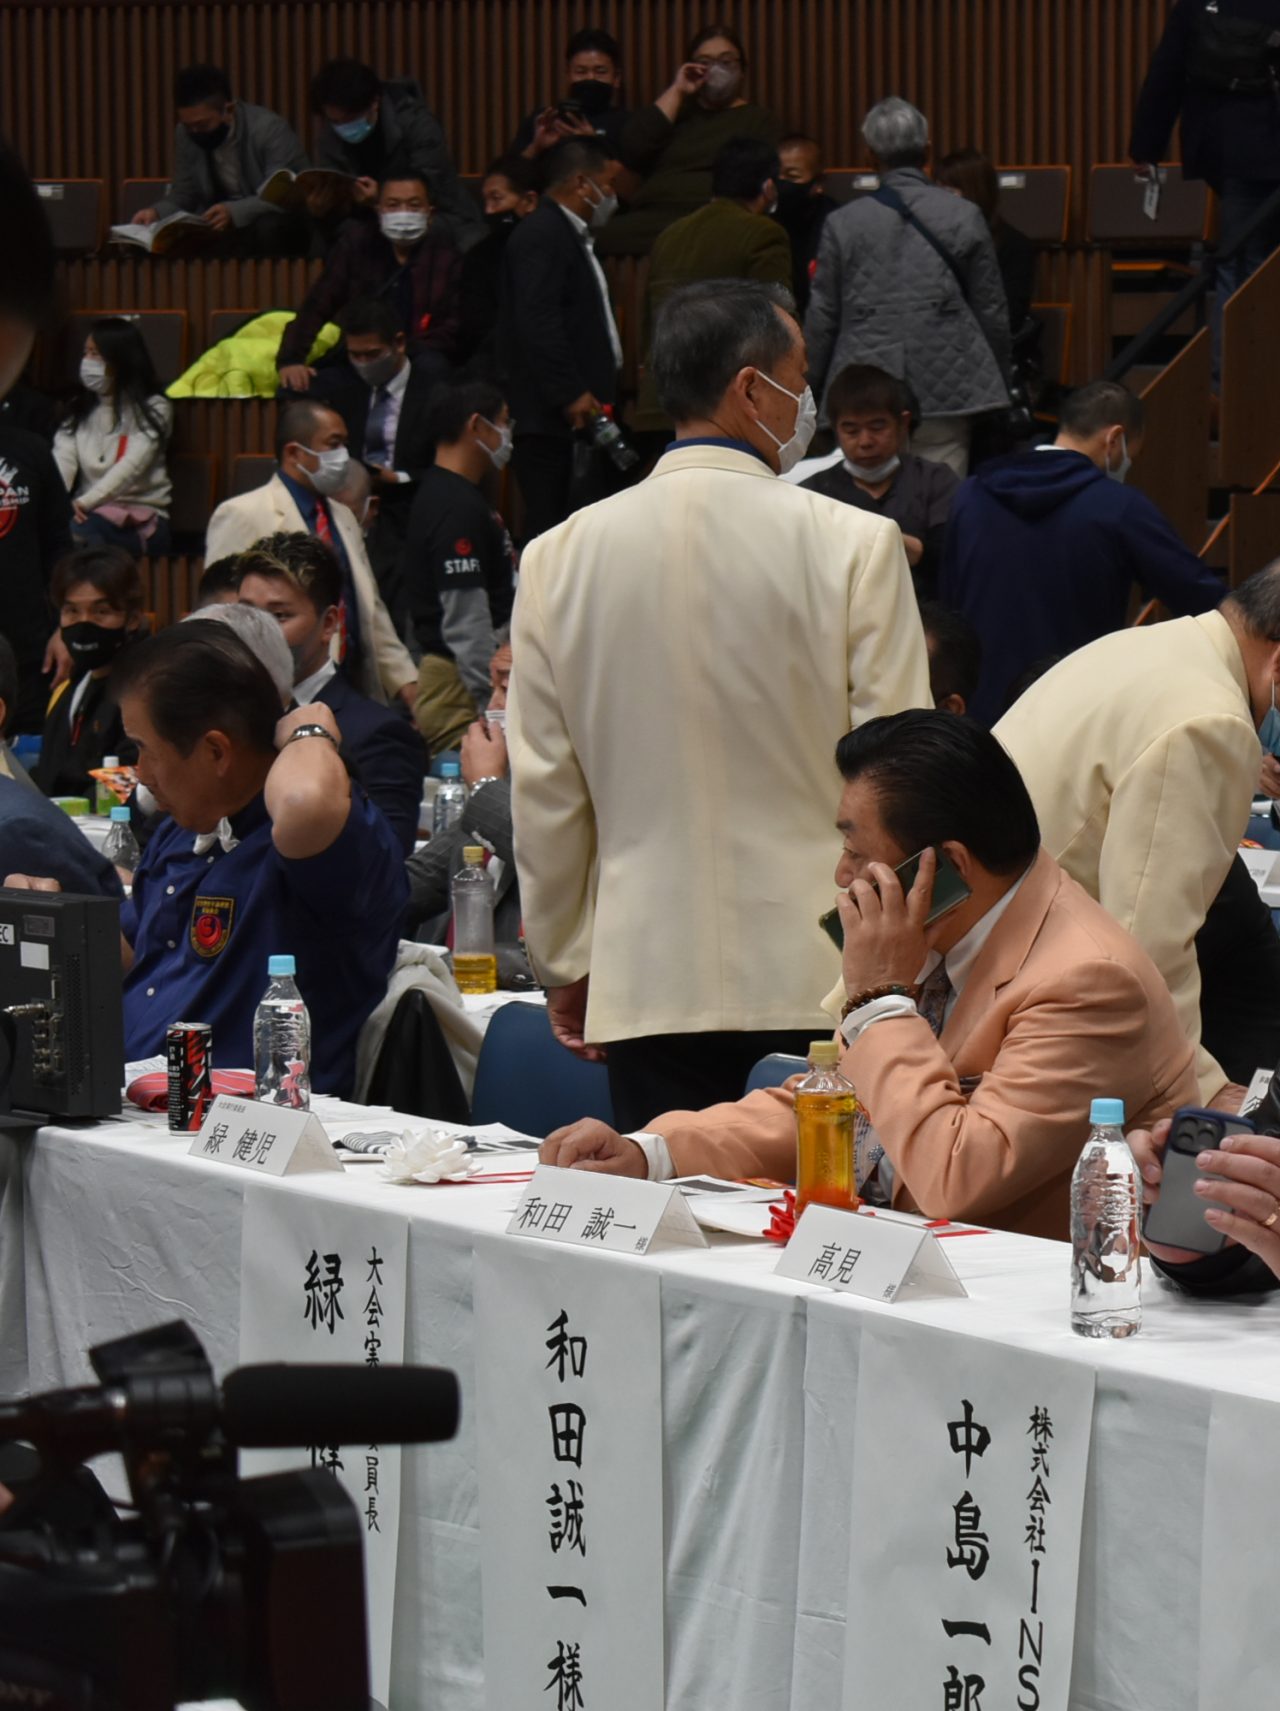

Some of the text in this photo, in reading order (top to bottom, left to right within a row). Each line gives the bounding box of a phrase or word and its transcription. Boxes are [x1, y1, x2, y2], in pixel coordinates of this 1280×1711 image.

[203, 1123, 277, 1164] 緑 健児
[517, 1197, 573, 1233] 和田
[580, 1207, 637, 1241] 誠一
[807, 1241, 862, 1285] 高見
[363, 1246, 384, 1533] 大会実員長
[544, 1309, 589, 1711] 和田誠一様
[941, 1399, 992, 1711] 中島一郎
